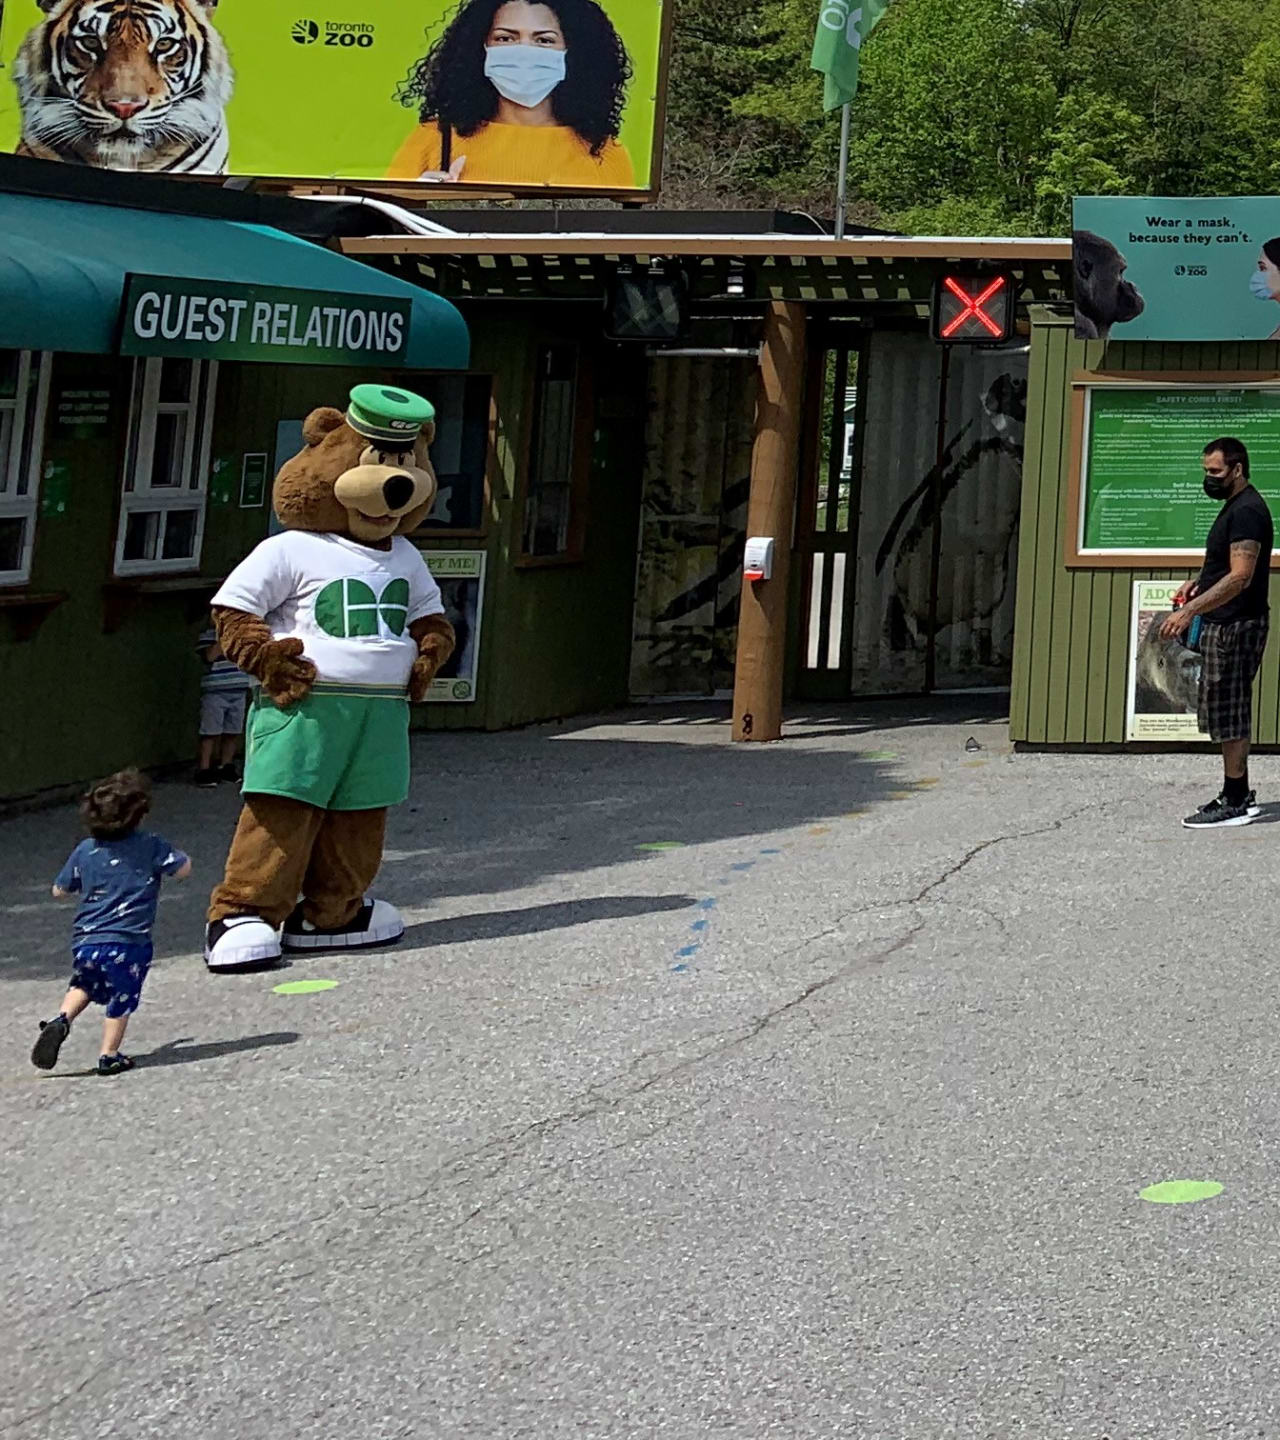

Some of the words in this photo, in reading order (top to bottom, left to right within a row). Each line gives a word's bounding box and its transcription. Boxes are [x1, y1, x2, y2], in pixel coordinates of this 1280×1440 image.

[325, 21, 375, 33] toronto
[324, 32, 374, 48] zoo
[1145, 216, 1181, 228] Wear
[1185, 219, 1193, 228] a
[1198, 216, 1236, 229] mask,
[1129, 232, 1179, 244] because
[1183, 232, 1211, 246] they
[1216, 231, 1252, 243] can't.
[133, 292, 247, 343] GUEST
[251, 301, 404, 352] RELATIONS
[1144, 588, 1177, 600] ADO
